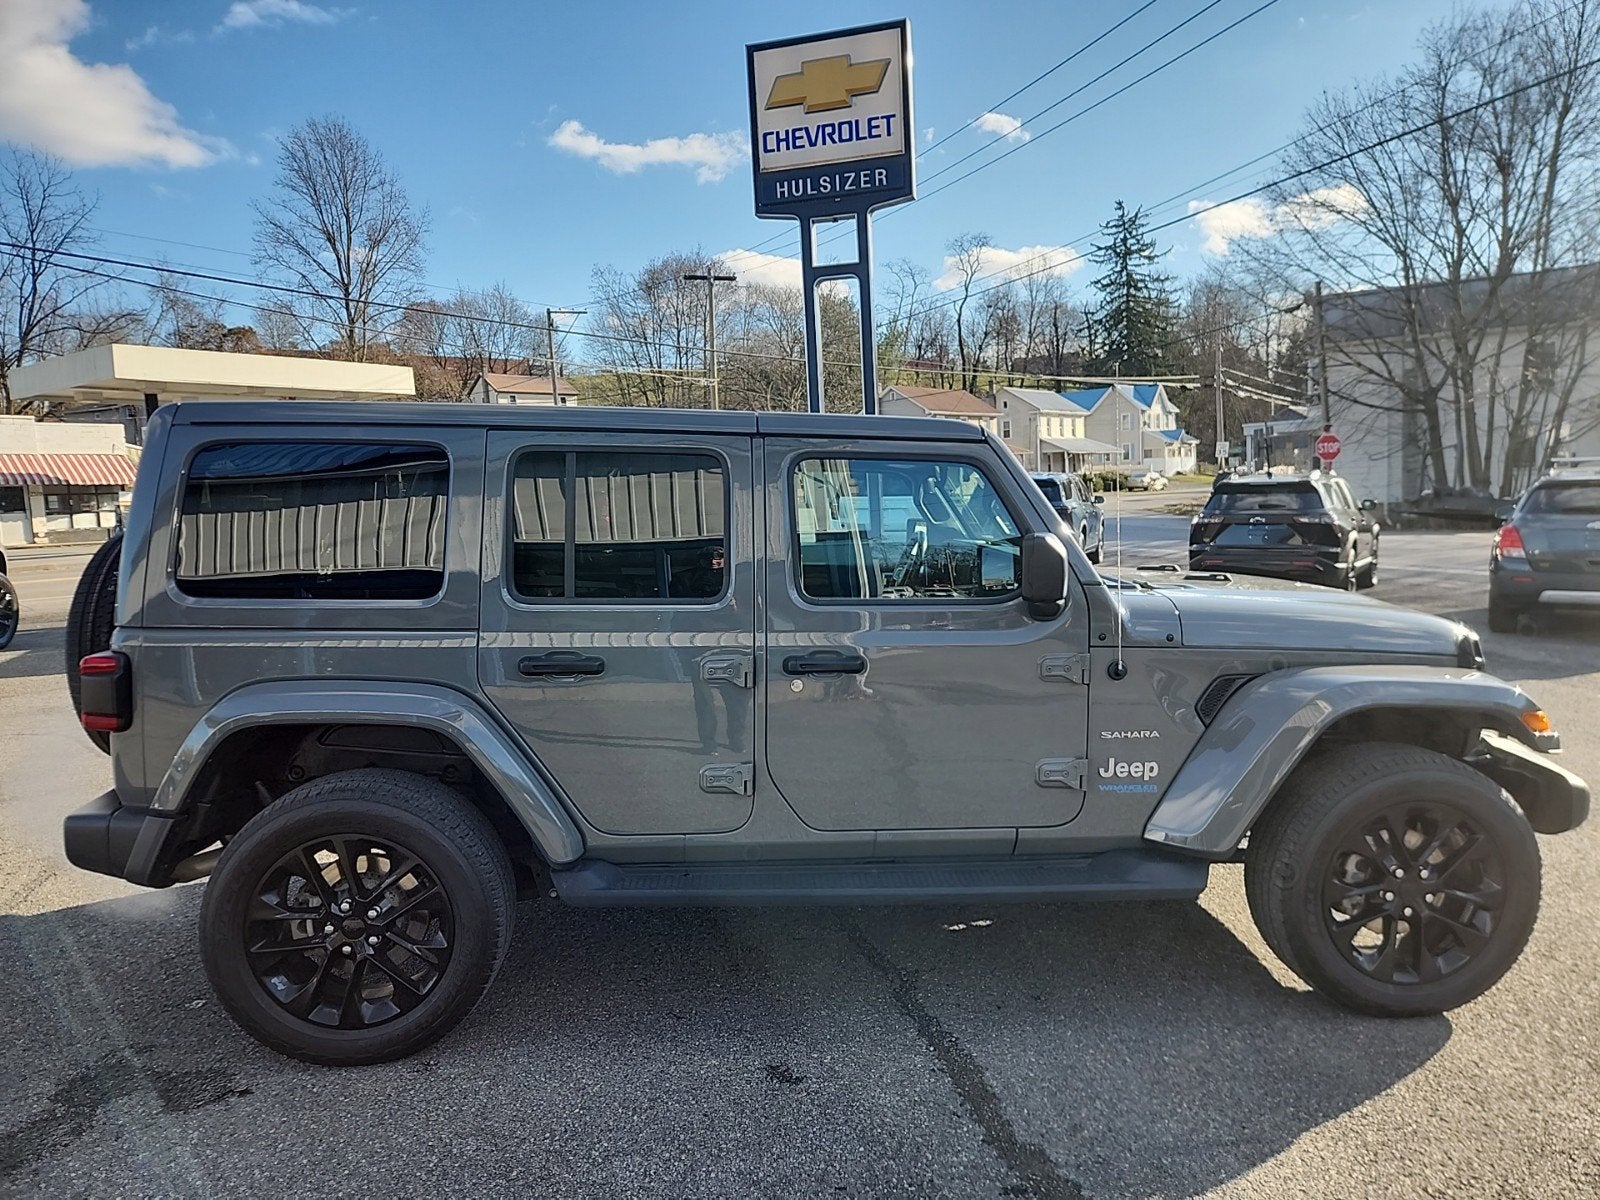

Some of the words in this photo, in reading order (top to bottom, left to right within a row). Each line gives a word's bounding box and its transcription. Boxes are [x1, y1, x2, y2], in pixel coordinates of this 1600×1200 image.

[762, 114, 896, 153] CHEVROLET
[776, 168, 887, 198] HULSIZER
[1317, 442, 1340, 453] STOP
[1101, 730, 1160, 739] SAHARA
[1099, 757, 1159, 780] Jeep
[1098, 784, 1158, 792] WRANGLER
